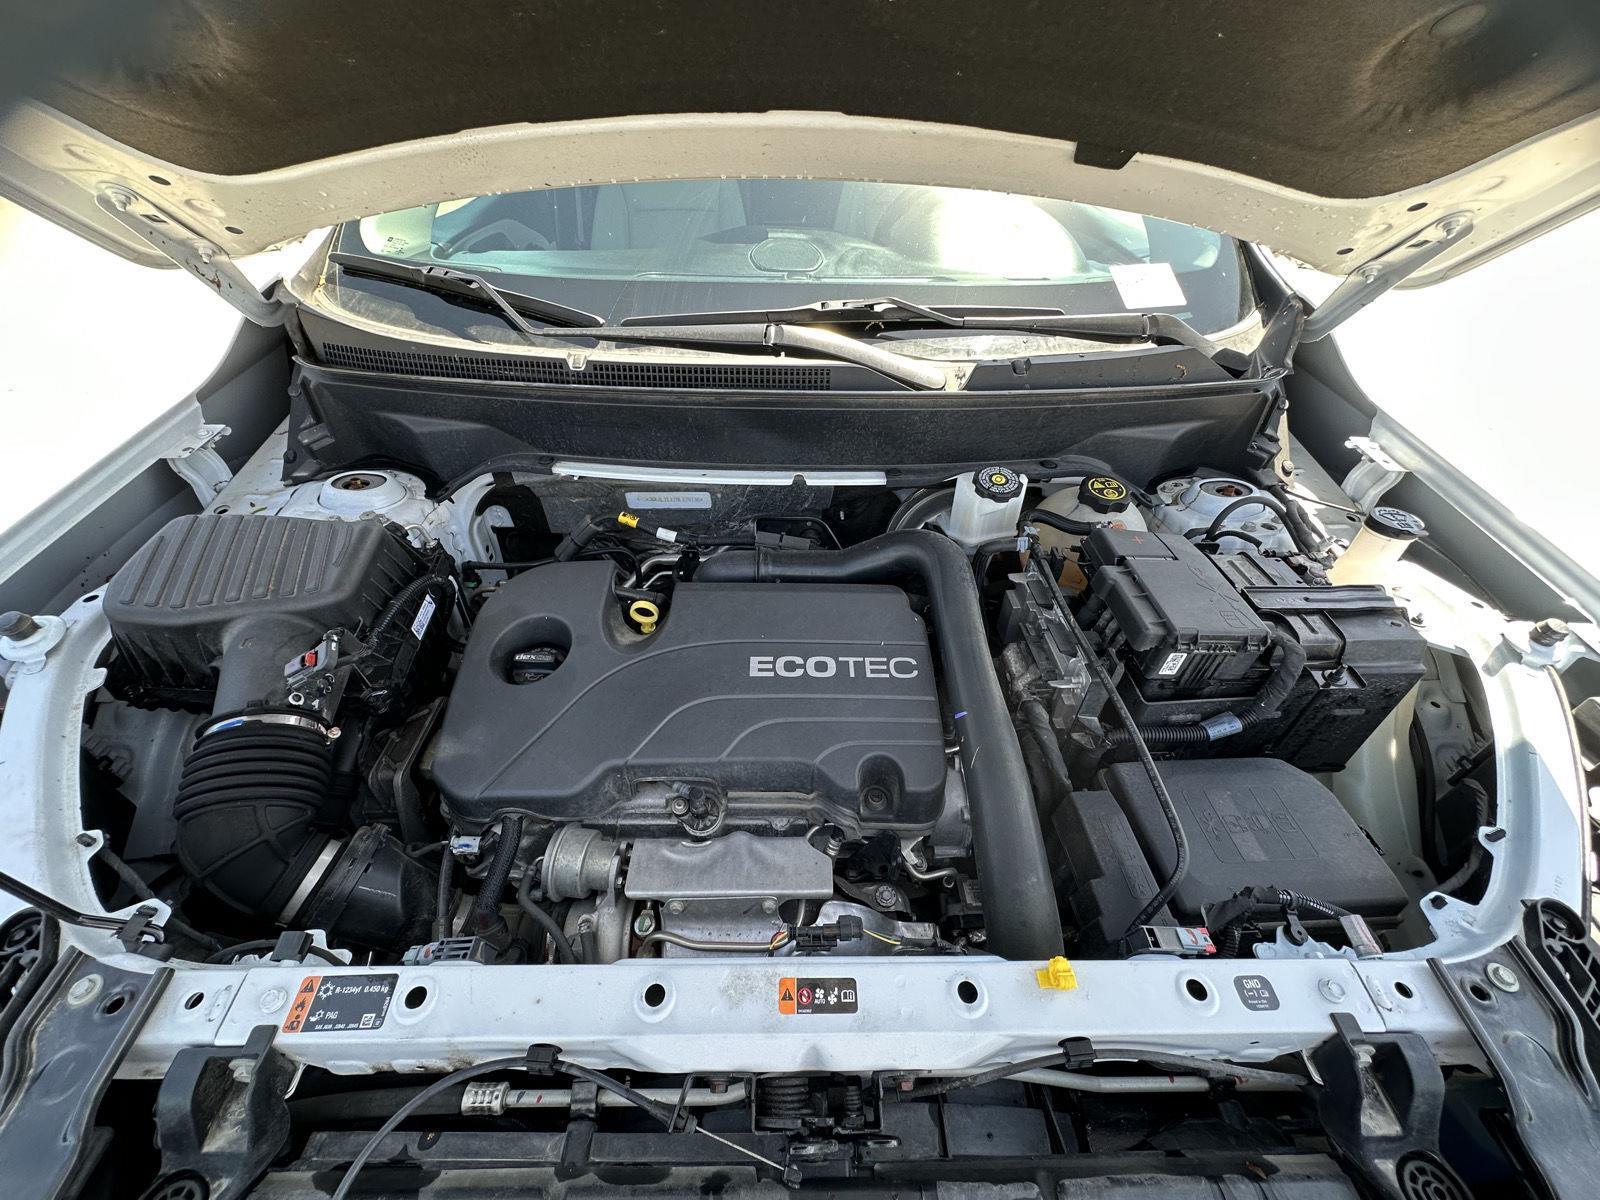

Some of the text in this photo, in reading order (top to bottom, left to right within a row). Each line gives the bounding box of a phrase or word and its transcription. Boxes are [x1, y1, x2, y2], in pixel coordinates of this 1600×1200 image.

[749, 655, 919, 679] ECOTEC
[1243, 979, 1261, 988] GND
[335, 985, 389, 994] R-1234yf 0.450 kg
[325, 1011, 339, 1019] PAG
